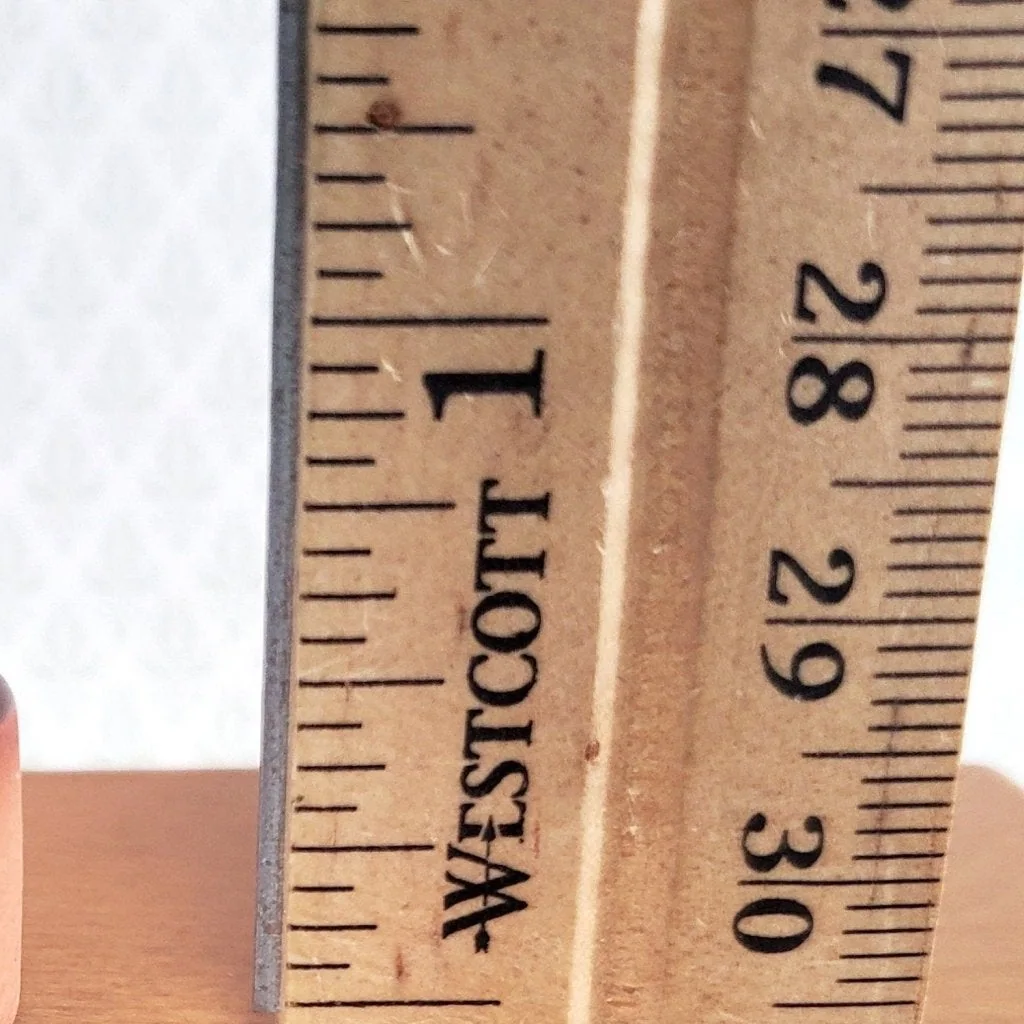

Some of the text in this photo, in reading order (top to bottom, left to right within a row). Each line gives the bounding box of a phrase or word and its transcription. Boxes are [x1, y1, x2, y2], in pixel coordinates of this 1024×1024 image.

[815, 0, 913, 124] 7
[422, 348, 545, 421] 1
[786, 261, 887, 424] 28
[761, 547, 855, 701] 29
[442, 478, 551, 942] WESTCOTT
[732, 812, 826, 954] 30
